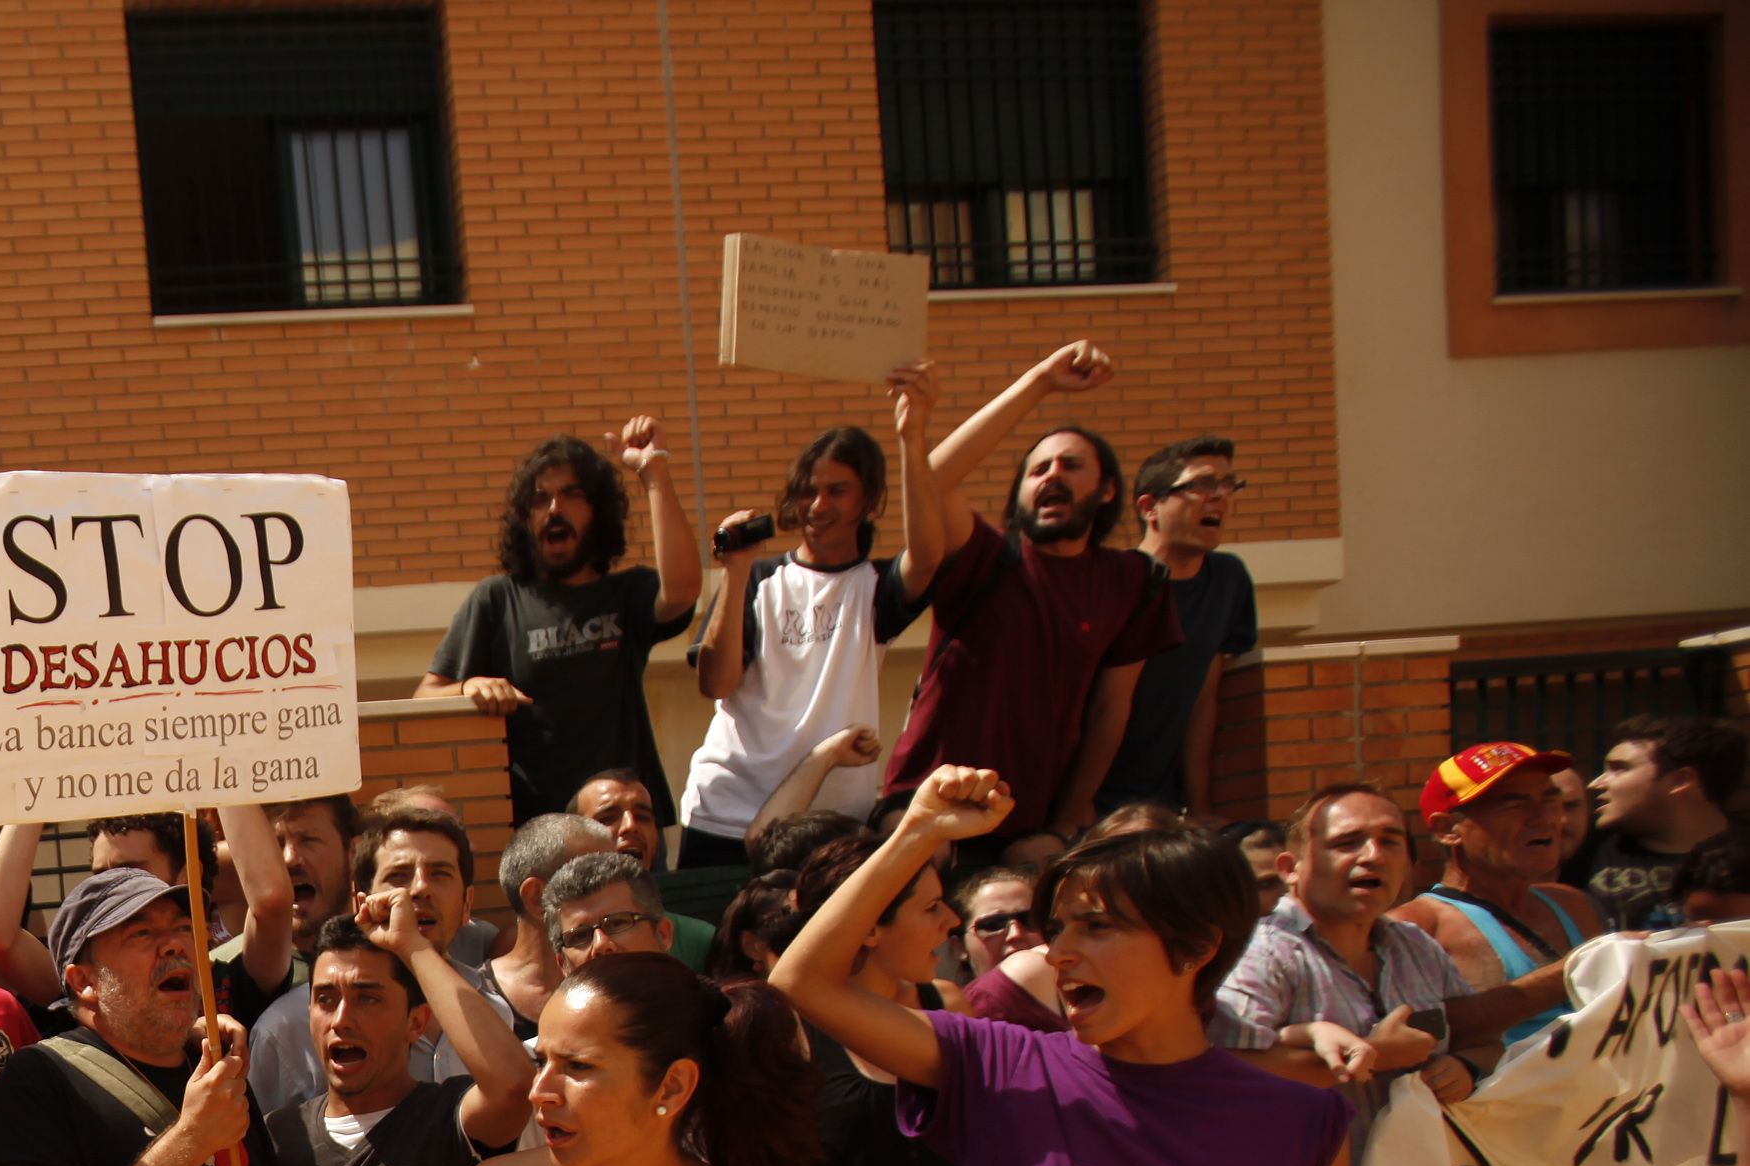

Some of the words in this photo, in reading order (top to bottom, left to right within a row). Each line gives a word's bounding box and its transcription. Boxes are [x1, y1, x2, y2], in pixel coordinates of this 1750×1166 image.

[2, 511, 305, 626] STOP
[527, 613, 623, 653] BLACK
[0, 632, 317, 695] DESAHUCIOS
[35, 714, 134, 751] banca
[144, 706, 268, 746] siempre
[277, 702, 343, 741] gana
[23, 773, 46, 812] y
[165, 758, 202, 793] da
[213, 756, 240, 790] la
[251, 754, 321, 793] gana
